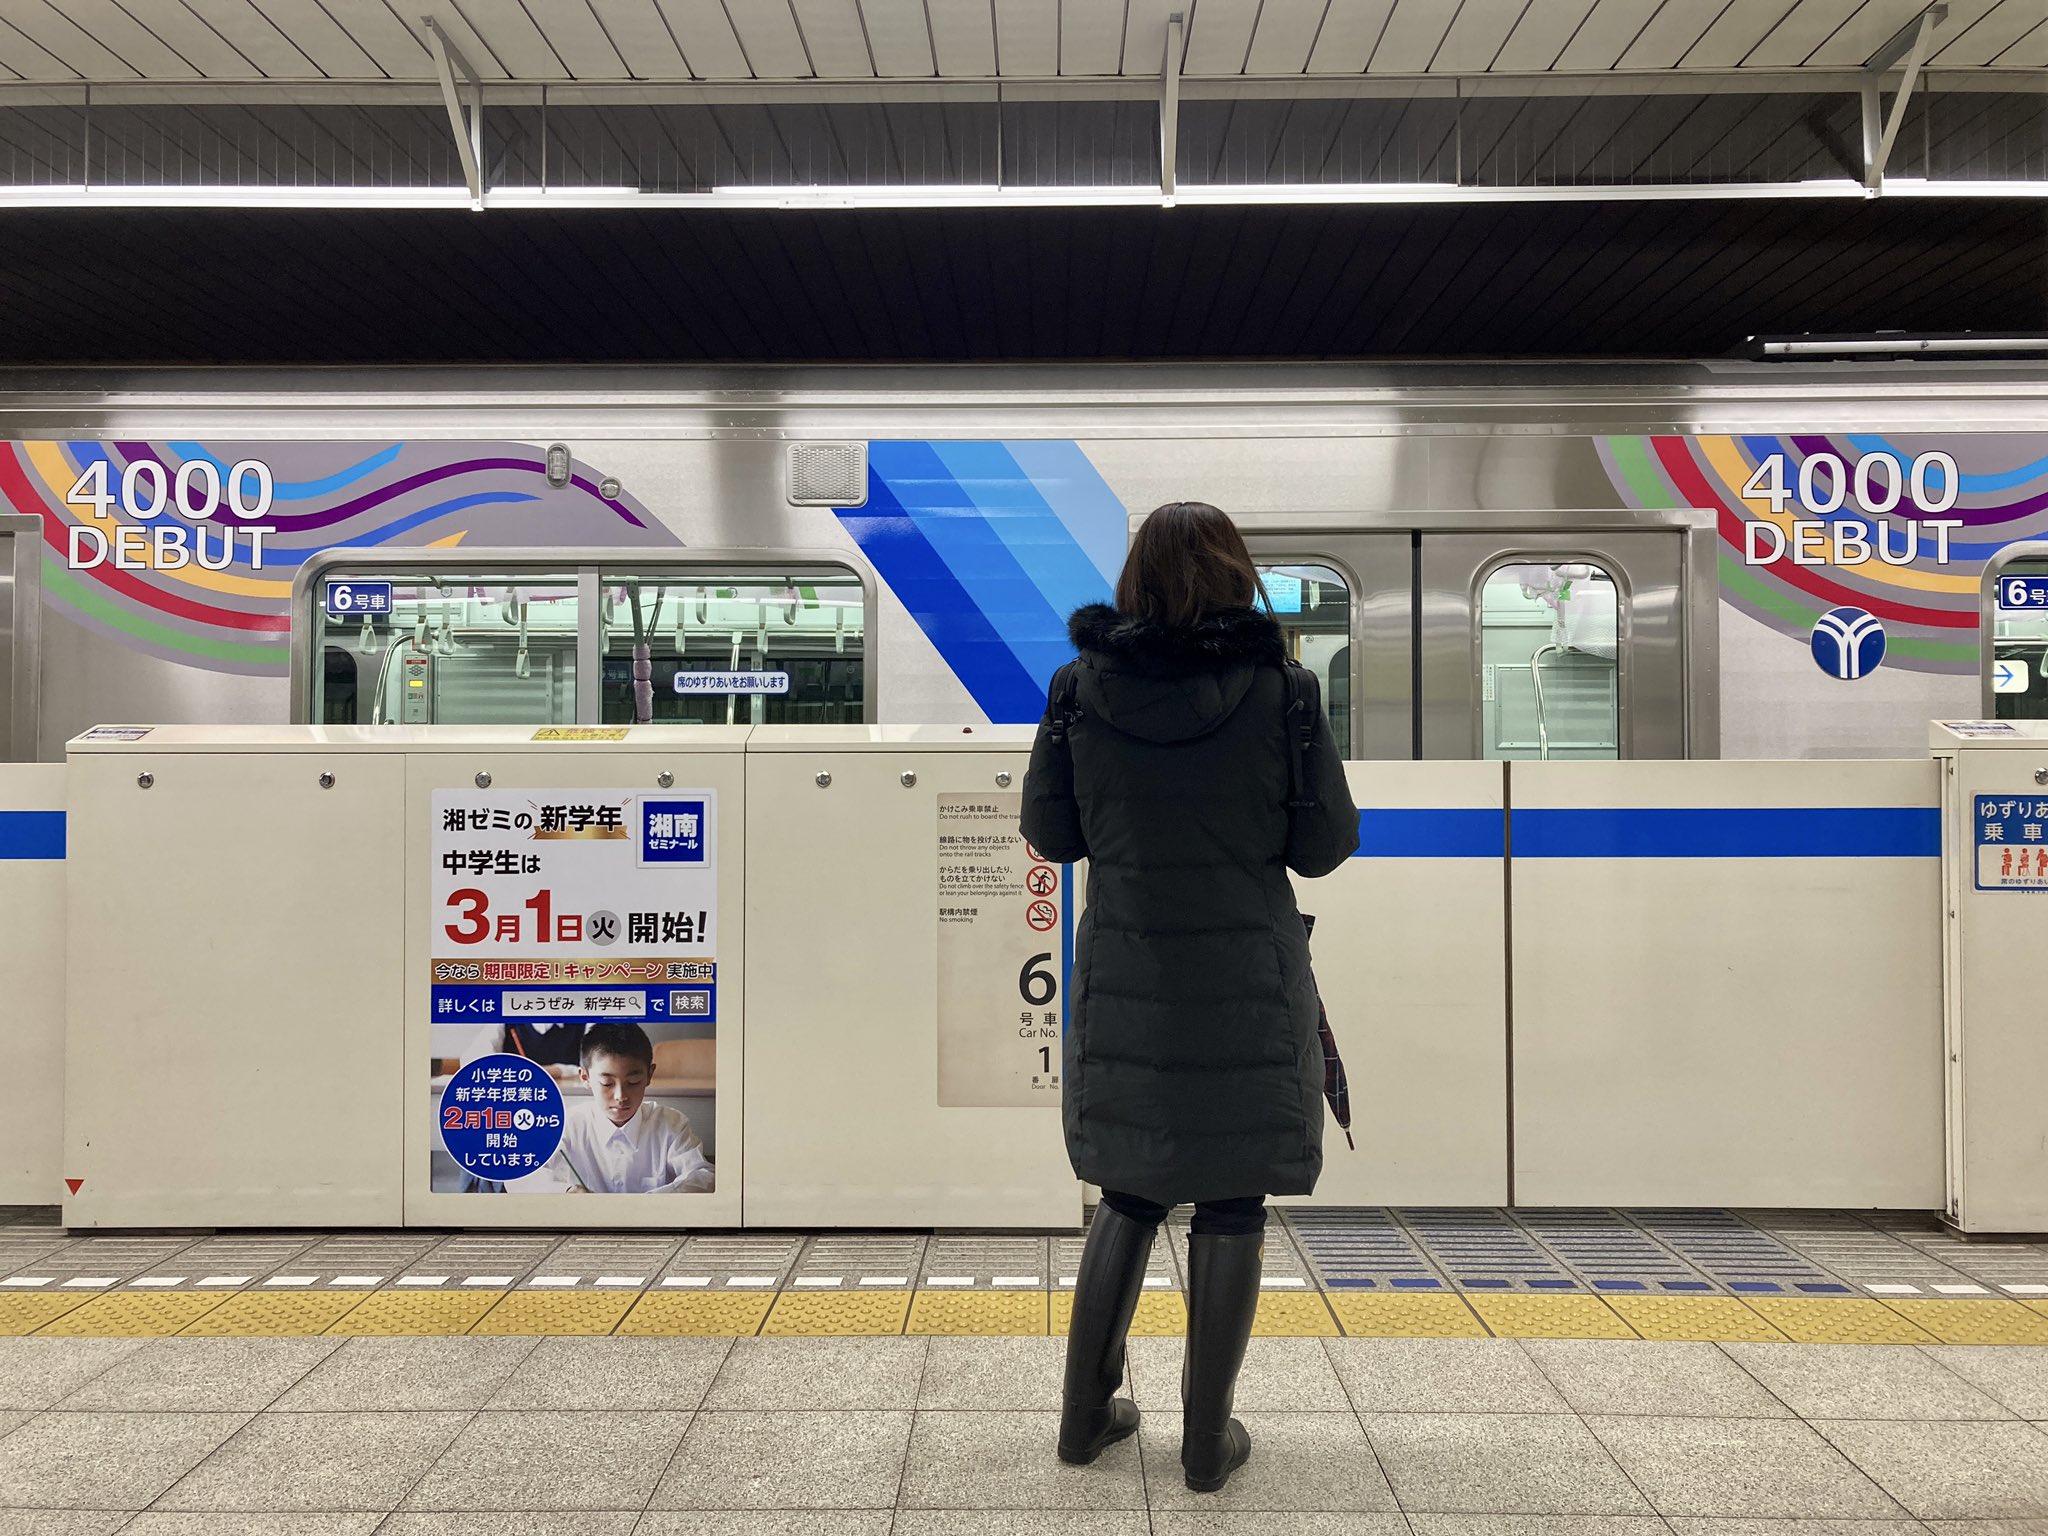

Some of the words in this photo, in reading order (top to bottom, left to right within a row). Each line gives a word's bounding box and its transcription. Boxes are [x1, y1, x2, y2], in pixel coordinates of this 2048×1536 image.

[65, 459, 274, 520] 4000
[1741, 450, 1961, 515] 4000
[66, 525, 278, 571] DEBUT
[1743, 519, 1964, 566] DEBUT
[333, 585, 386, 610] 6号車
[2008, 580, 2048, 605] 6号
[677, 676, 786, 689] 席のゆずりあいをお願いします
[939, 805, 999, 813] かけこみ乗車禁止
[649, 813, 698, 838] 湘南
[648, 839, 699, 850] ゼミナール
[939, 836, 1022, 844] 線路に物を投げ込まない
[442, 850, 541, 876] 中学生は
[939, 866, 1013, 874] からだを乗り出したり、
[940, 875, 1006, 883] ものを立てかけない
[939, 908, 978, 916] 駅構内禁煙
[1019, 952, 1057, 1006] 6
[438, 998, 495, 1014] 詳しくは
[510, 997, 575, 1011] しょうぜみ
[584, 996, 626, 1011] 新学年
[651, 999, 665, 1012] で
[675, 995, 705, 1010] 検索
[1019, 1012, 1058, 1027] 号車
[1019, 1028, 1037, 1038] Car
[1040, 1028, 1058, 1038] No.
[1038, 1046, 1050, 1073] 1
[471, 1068, 532, 1083] 小学生の
[455, 1087, 547, 1102] 新学年授業は
[486, 1134, 518, 1148] 開始
[464, 1153, 541, 1168] しています。
